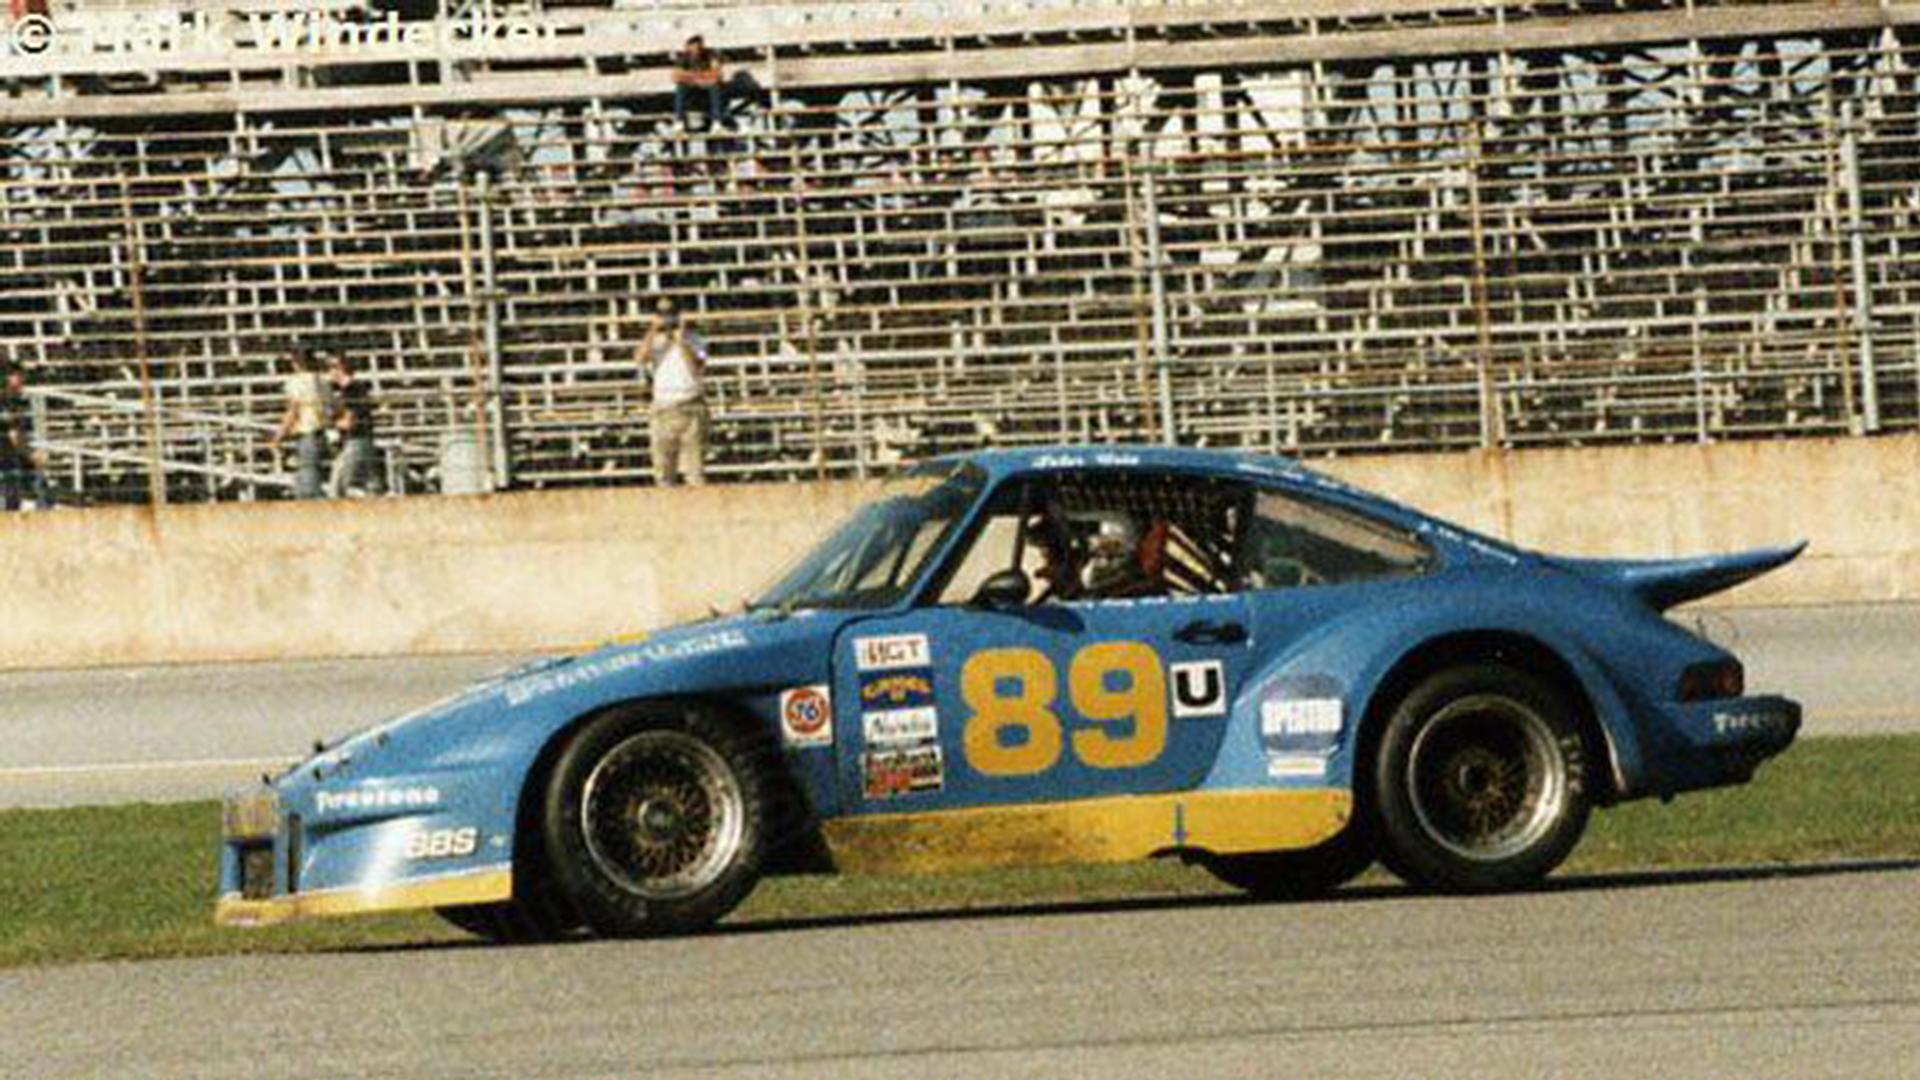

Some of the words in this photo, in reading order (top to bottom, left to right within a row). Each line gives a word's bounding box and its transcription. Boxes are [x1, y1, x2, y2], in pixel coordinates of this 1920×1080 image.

[960, 640, 1167, 776] 89
[1174, 667, 1221, 708] U
[405, 826, 480, 859] BBS
